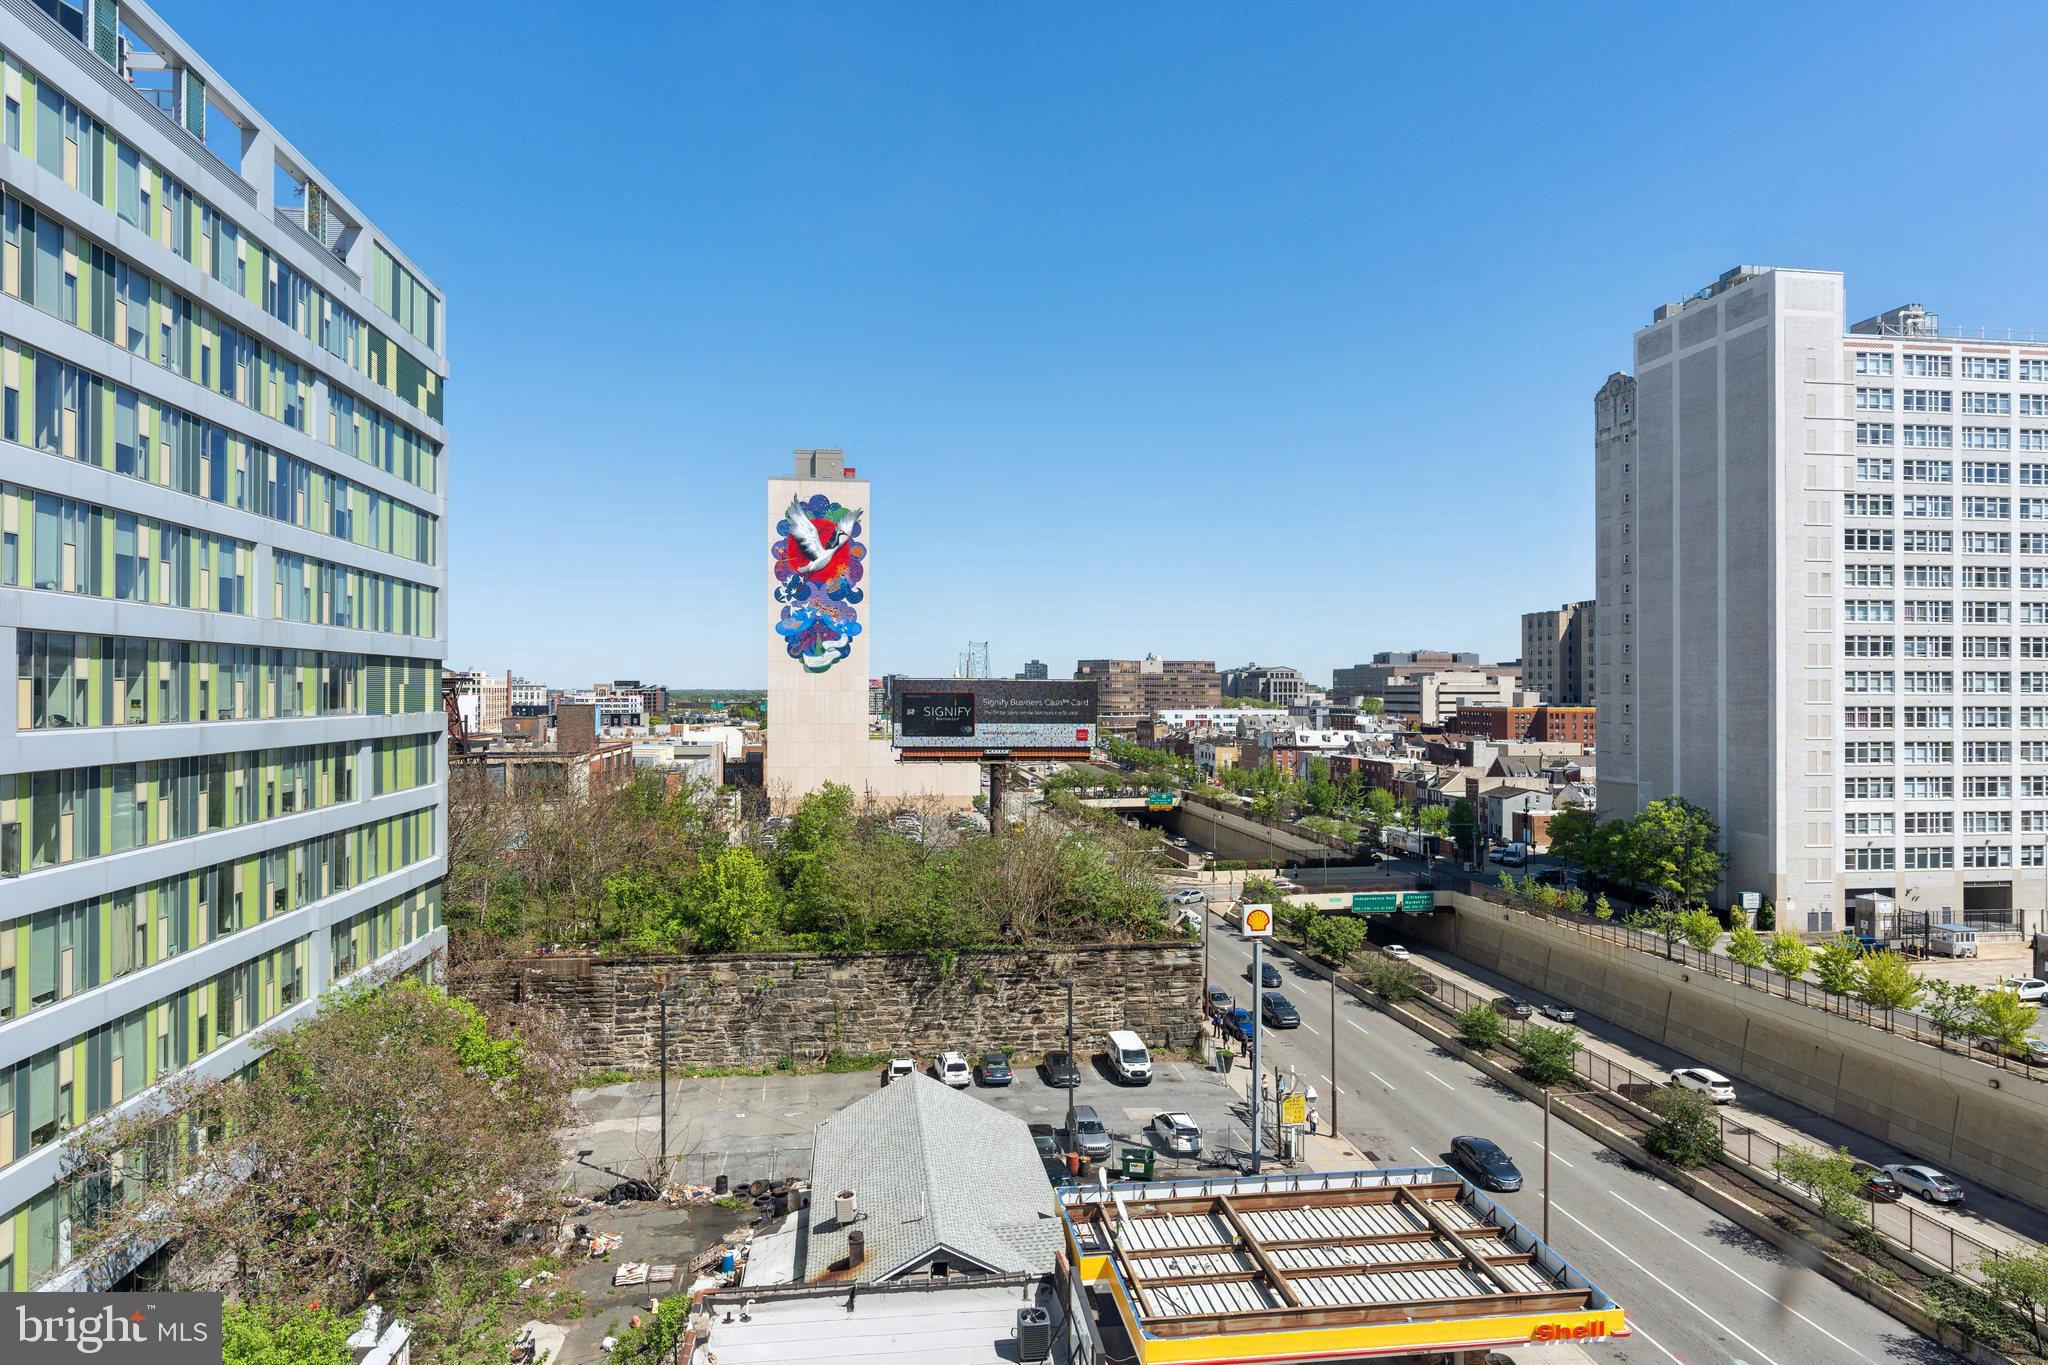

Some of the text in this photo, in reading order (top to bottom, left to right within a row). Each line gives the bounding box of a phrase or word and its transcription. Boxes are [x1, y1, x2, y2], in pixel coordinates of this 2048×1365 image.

[983, 698, 1009, 708] Signify
[1010, 698, 1043, 706] Business
[1071, 698, 1089, 706] Card
[923, 706, 972, 717] SIGNIFY
[1535, 1320, 1605, 1342] Shell
